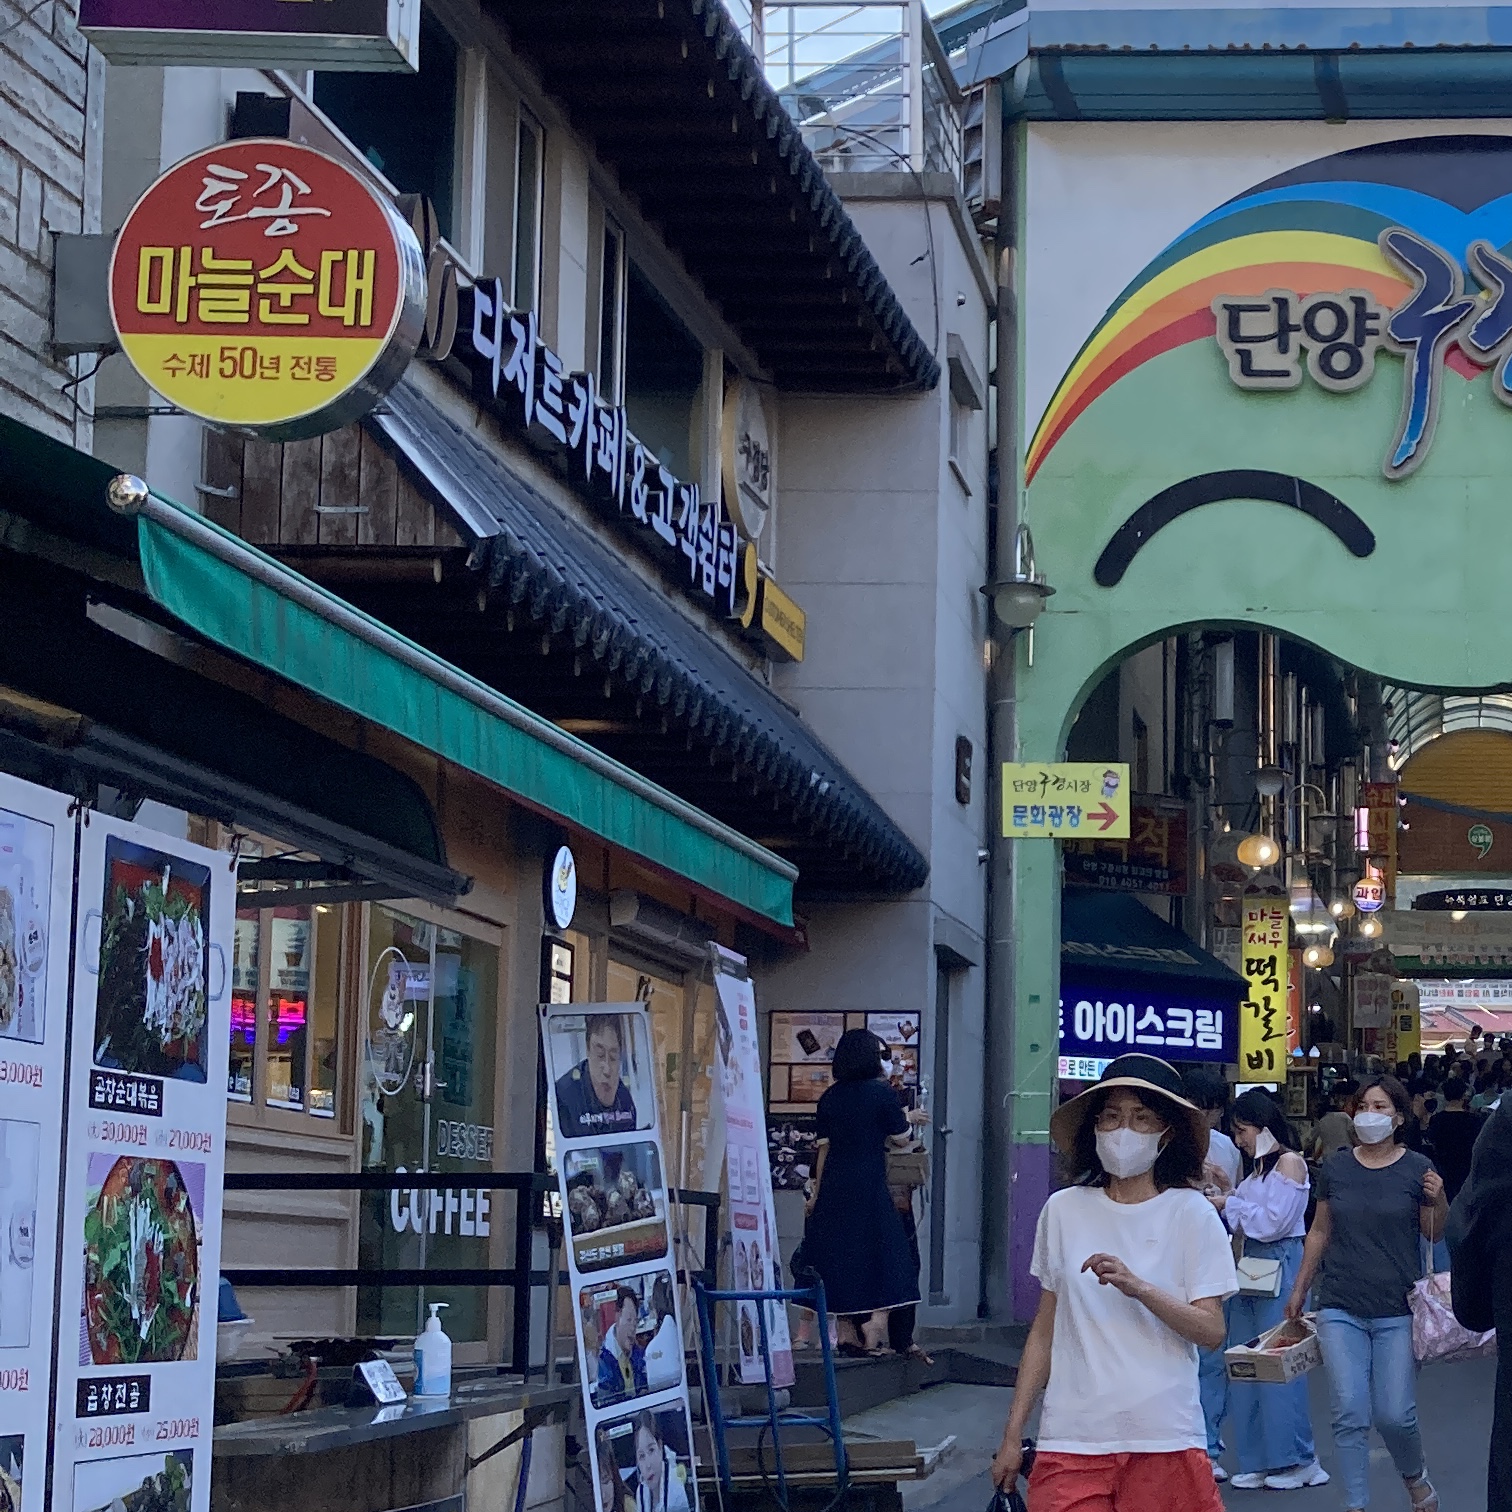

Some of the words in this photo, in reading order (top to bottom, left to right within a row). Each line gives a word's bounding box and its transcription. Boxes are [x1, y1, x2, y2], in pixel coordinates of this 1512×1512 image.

[195, 163, 331, 237] 토종
[136, 245, 376, 328] 마늘순대
[162, 352, 211, 380] 수제
[218, 346, 281, 381] 50년
[290, 354, 337, 382] 전통
[1012, 771, 1091, 799] 단양구경시장
[1012, 804, 1082, 829] 문화광장
[1248, 907, 1284, 930] 마늘
[1248, 932, 1283, 949] 새우
[1074, 999, 1223, 1050] 아이스크림
[1243, 954, 1285, 1071] 떡갈비
[94, 1075, 159, 1110] 곱창순대볶음
[390, 1165, 490, 1237] COFFEE
[87, 1381, 140, 1412] 곱창전골
